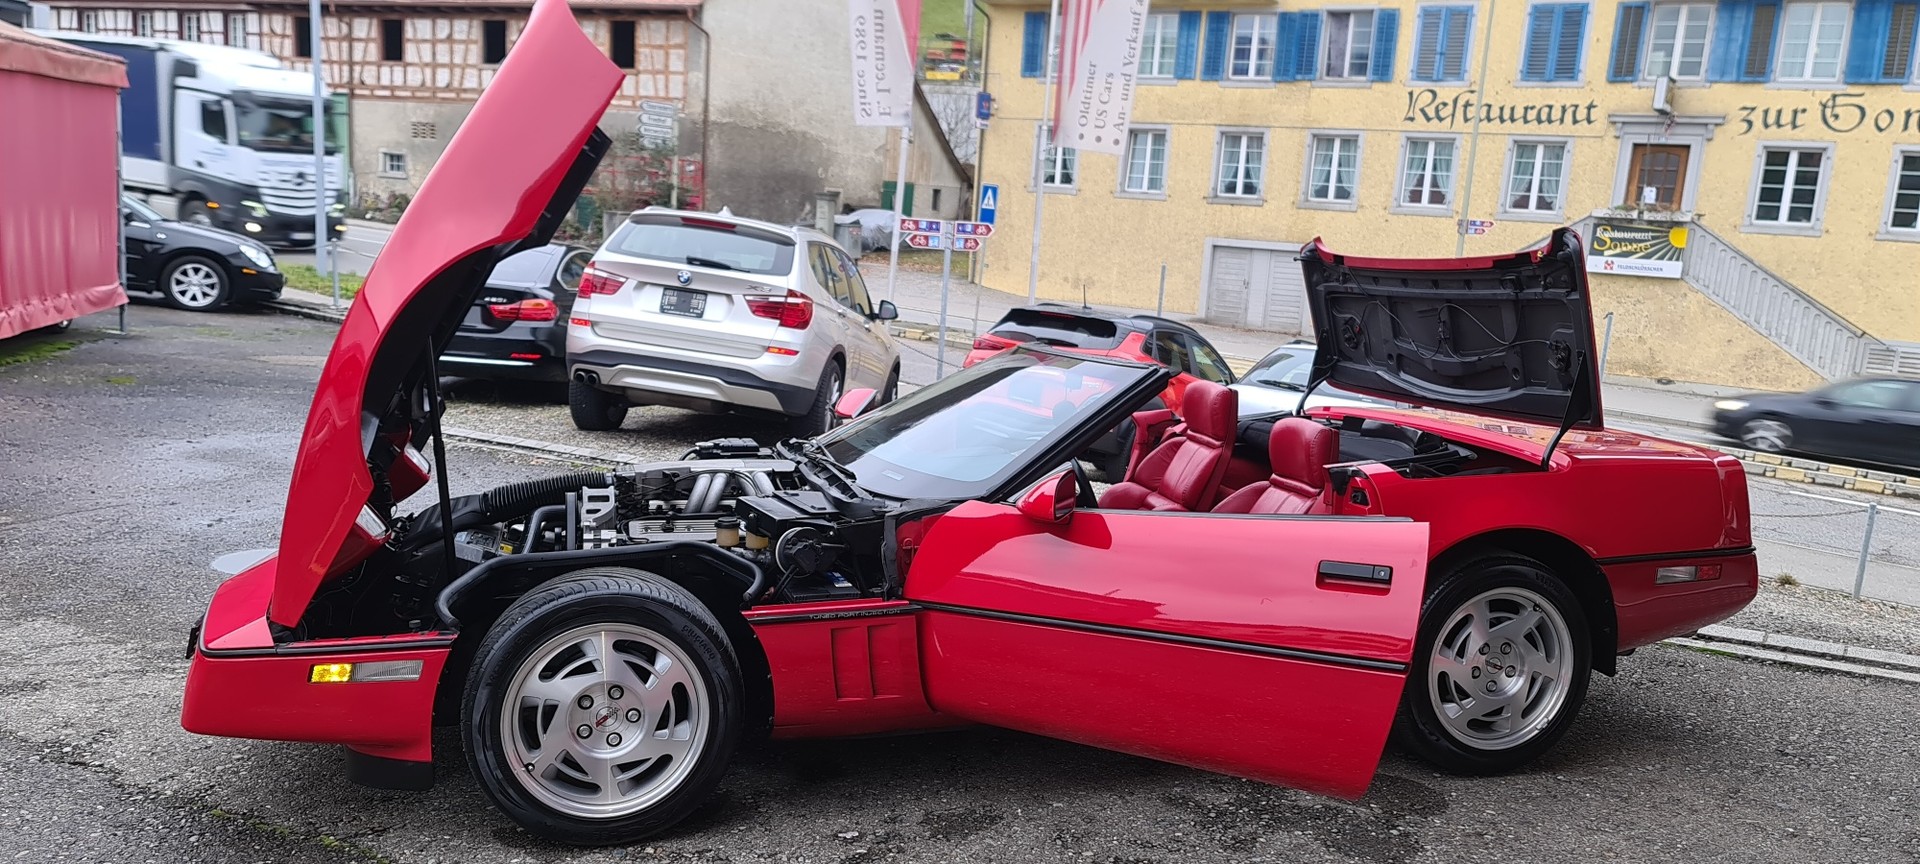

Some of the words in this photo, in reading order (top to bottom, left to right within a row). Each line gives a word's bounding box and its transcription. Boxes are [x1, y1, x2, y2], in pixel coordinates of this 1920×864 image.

[1122, 6, 1141, 67] Verkauf
[1078, 60, 1097, 127] Oldtimer
[1098, 71, 1115, 105] Cars
[1120, 72, 1132, 101] und
[1094, 109, 1108, 129] US
[1113, 105, 1126, 133] An-
[1738, 105, 1807, 136] zur
[1593, 226, 1651, 252] Sonne
